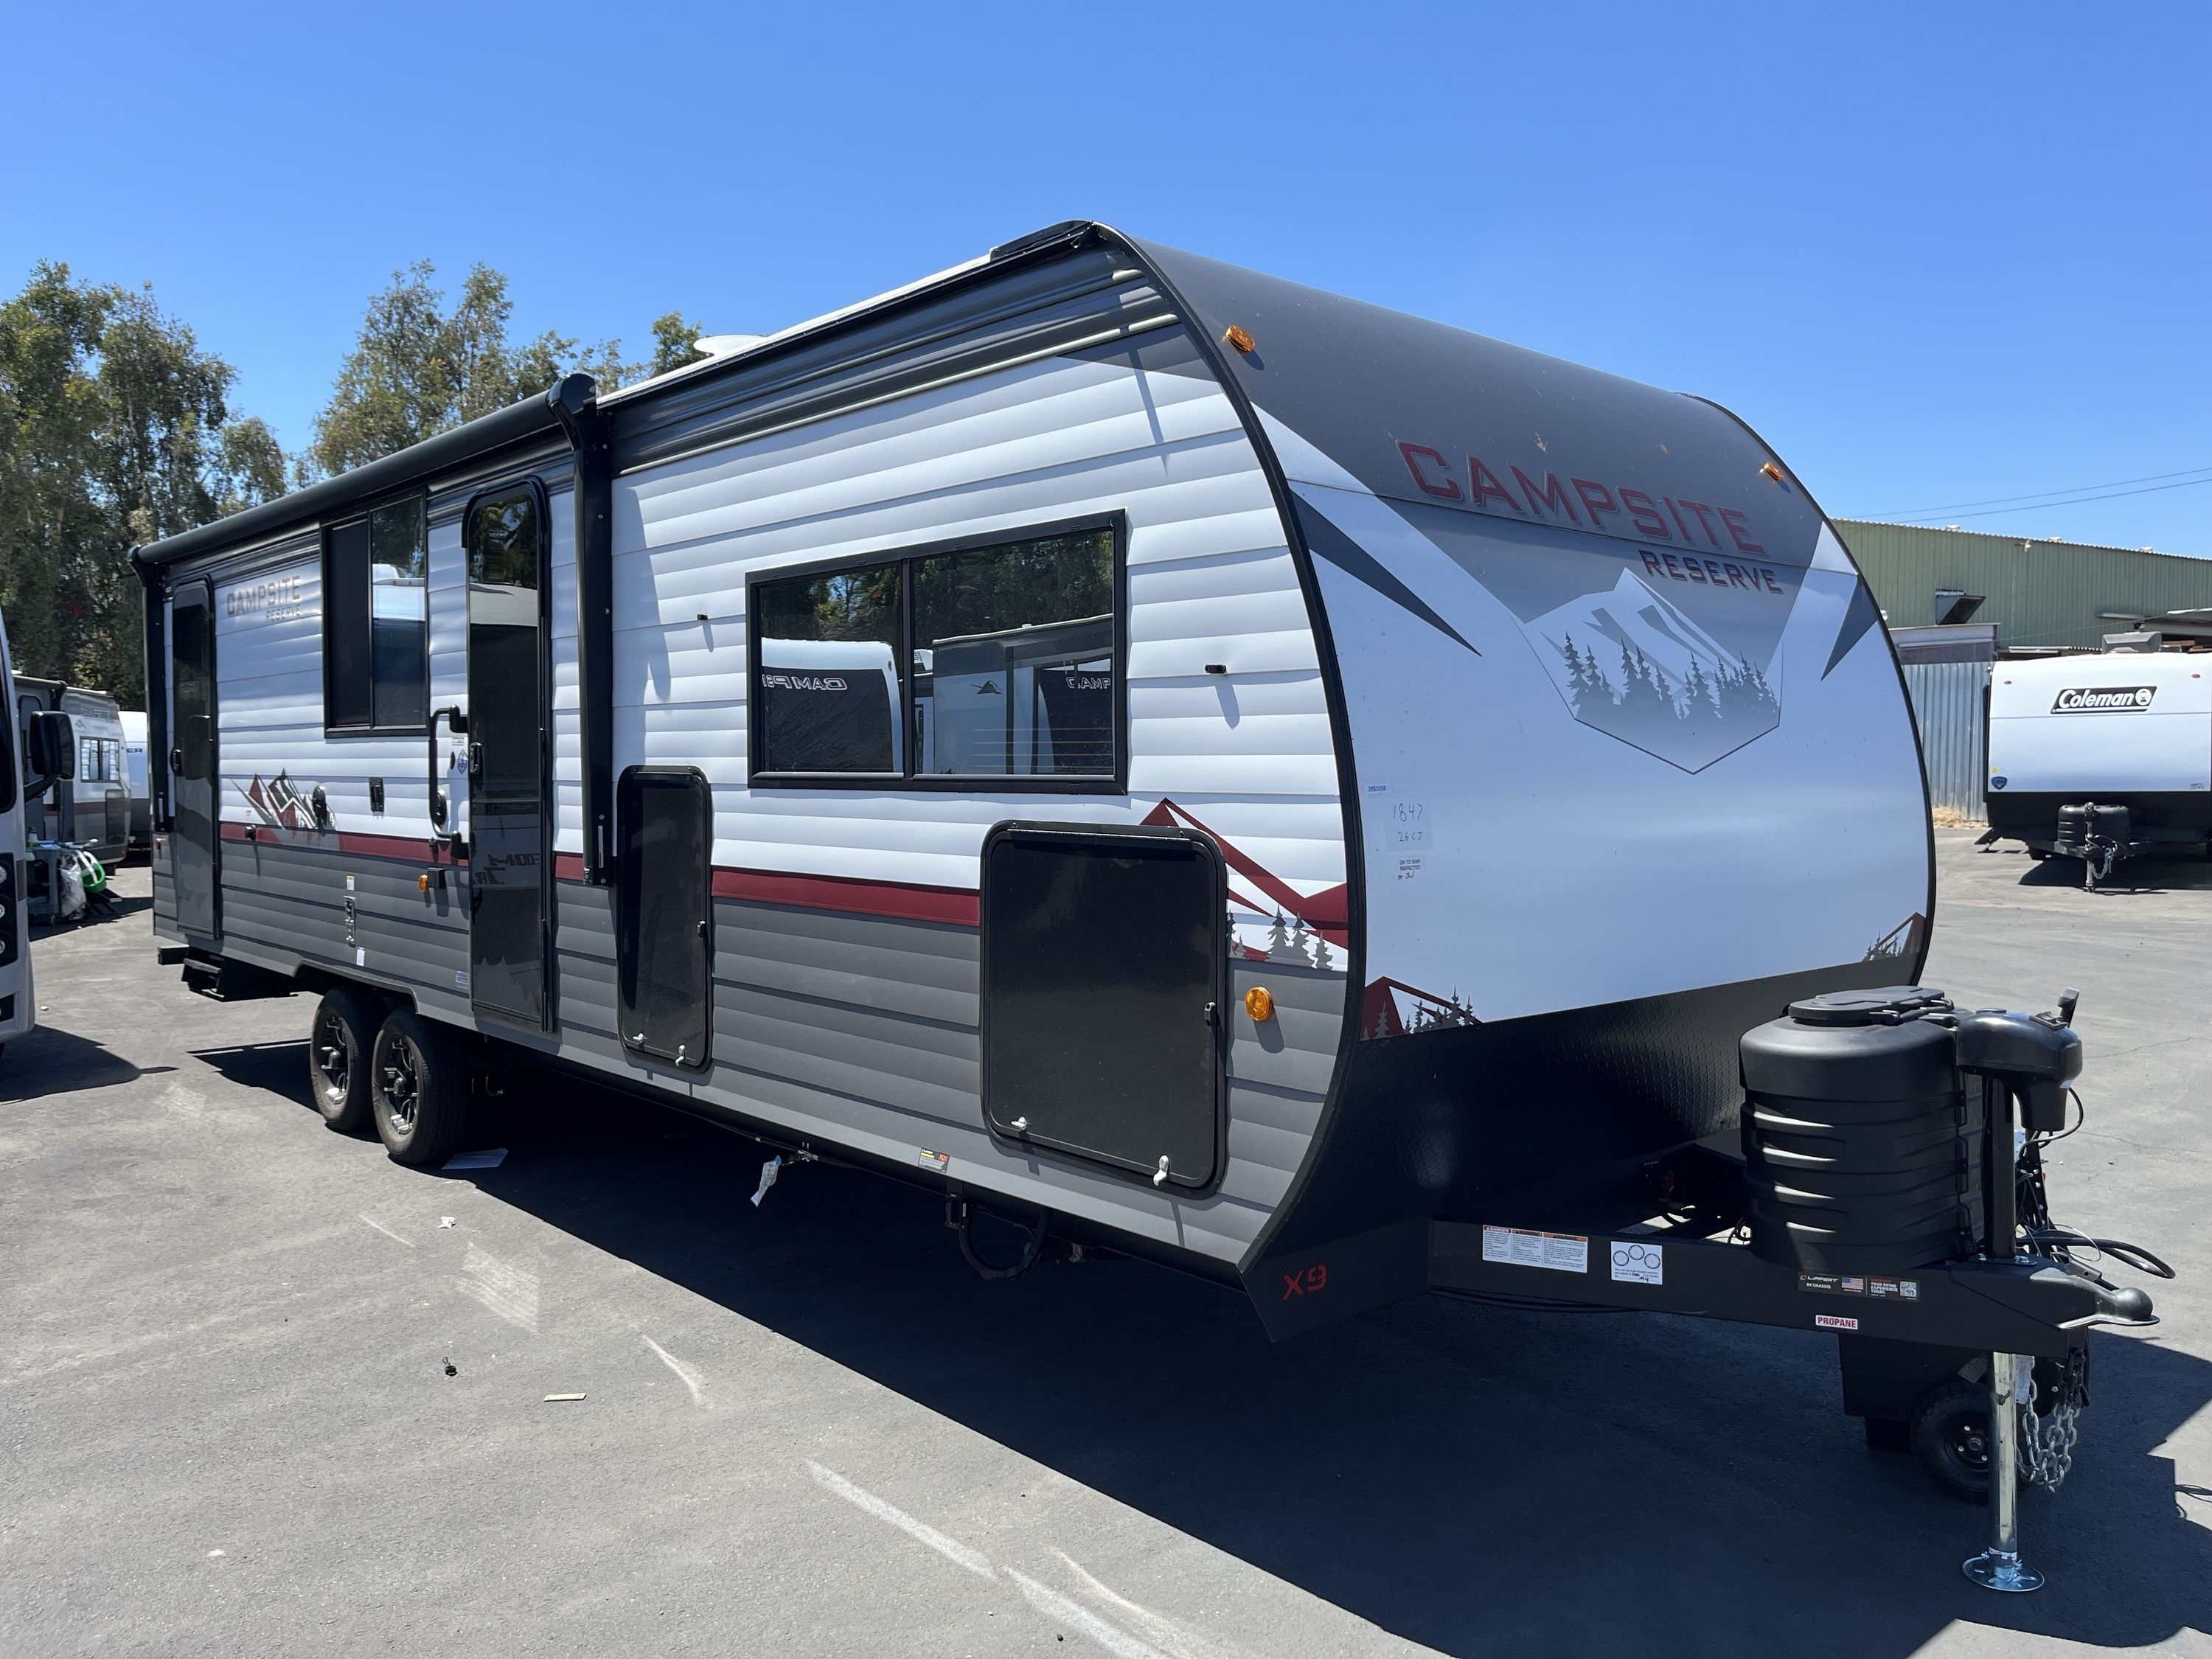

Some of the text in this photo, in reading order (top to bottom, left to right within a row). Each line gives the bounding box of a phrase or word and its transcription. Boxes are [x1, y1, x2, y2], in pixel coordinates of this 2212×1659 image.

[1395, 440, 1765, 554] CAMPSITE
[1638, 549, 1784, 594] RESERVE
[226, 575, 301, 617] CAMPSITE
[265, 604, 301, 622] RESERVE
[2059, 689, 2135, 708] Coleman
[1393, 803, 1423, 821] 1847
[1282, 1264, 1327, 1300] X9
[1818, 1316, 1856, 1328] PROPANE
